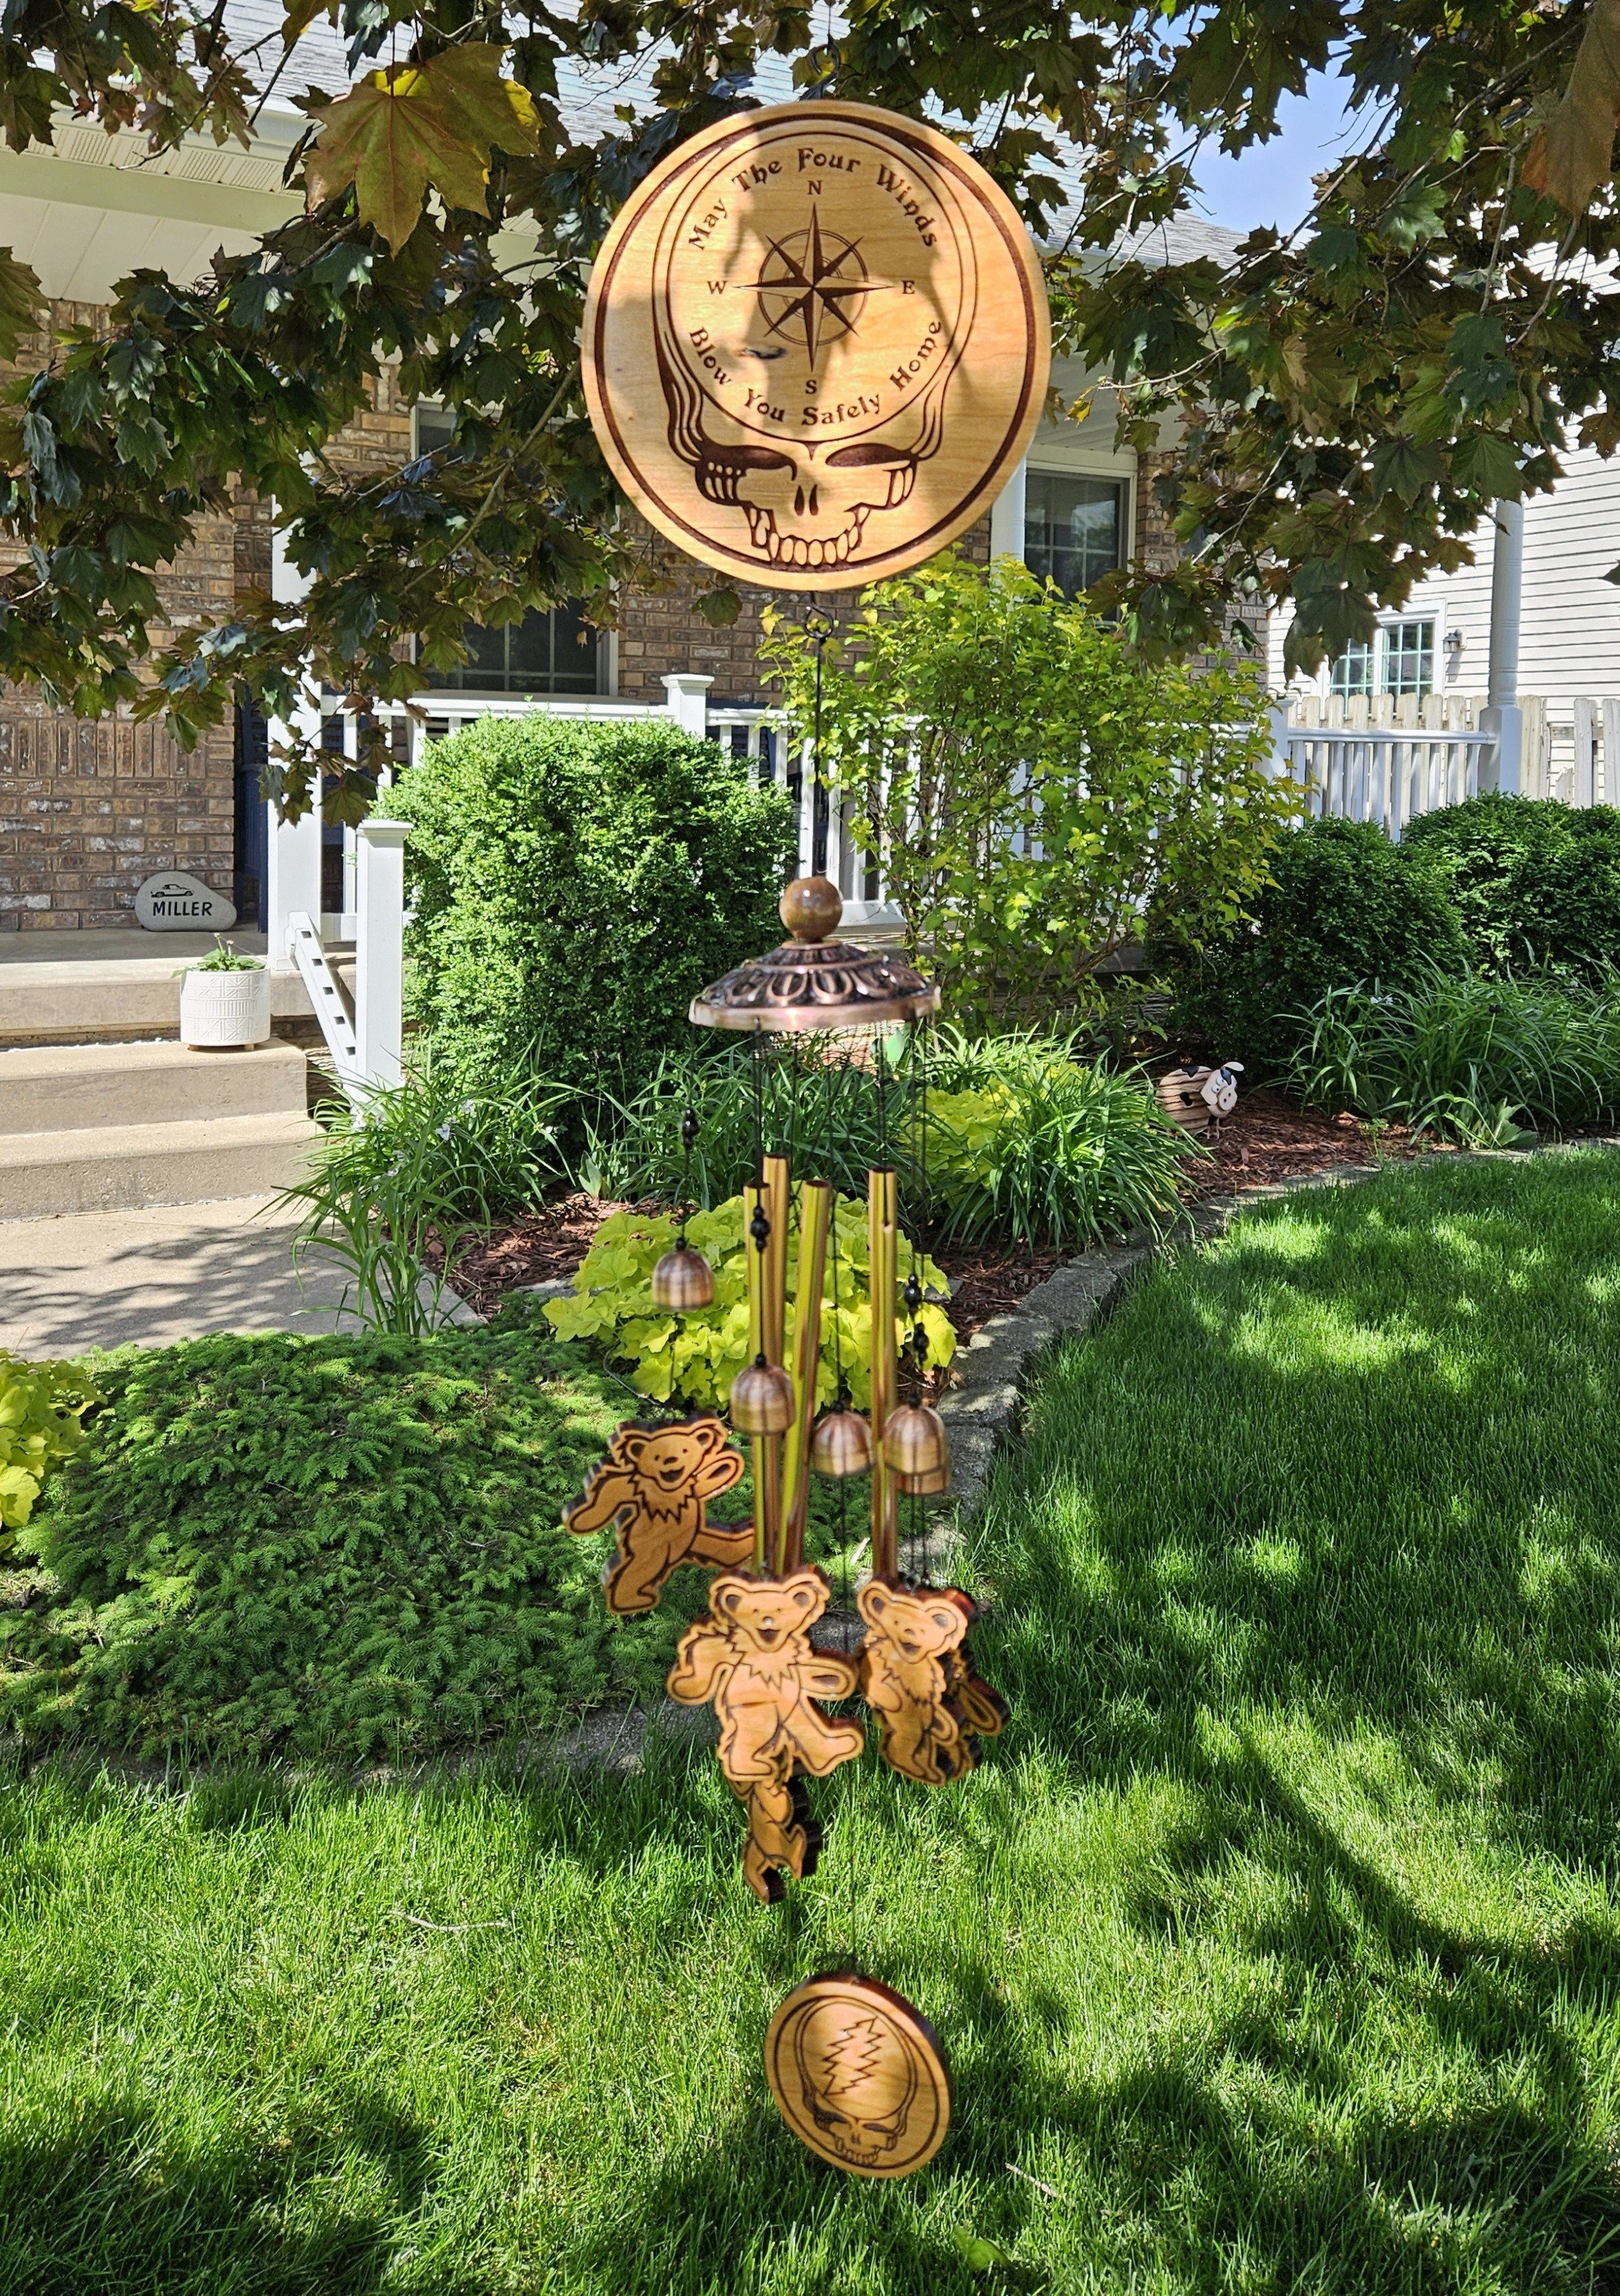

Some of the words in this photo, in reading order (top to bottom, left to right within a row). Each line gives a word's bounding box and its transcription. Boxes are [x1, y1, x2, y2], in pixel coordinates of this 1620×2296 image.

[808, 181, 822, 195] N
[688, 198, 729, 251] May
[731, 159, 782, 193] The
[798, 147, 861, 172] Four
[876, 164, 937, 248] Winds
[708, 281, 727, 294] W
[903, 281, 915, 294] E
[689, 326, 734, 386] Blow
[745, 389, 785, 422] You
[801, 393, 882, 426] Safely
[889, 321, 942, 392] Home
[805, 379, 817, 394] S
[152, 901, 212, 916] MILLER
